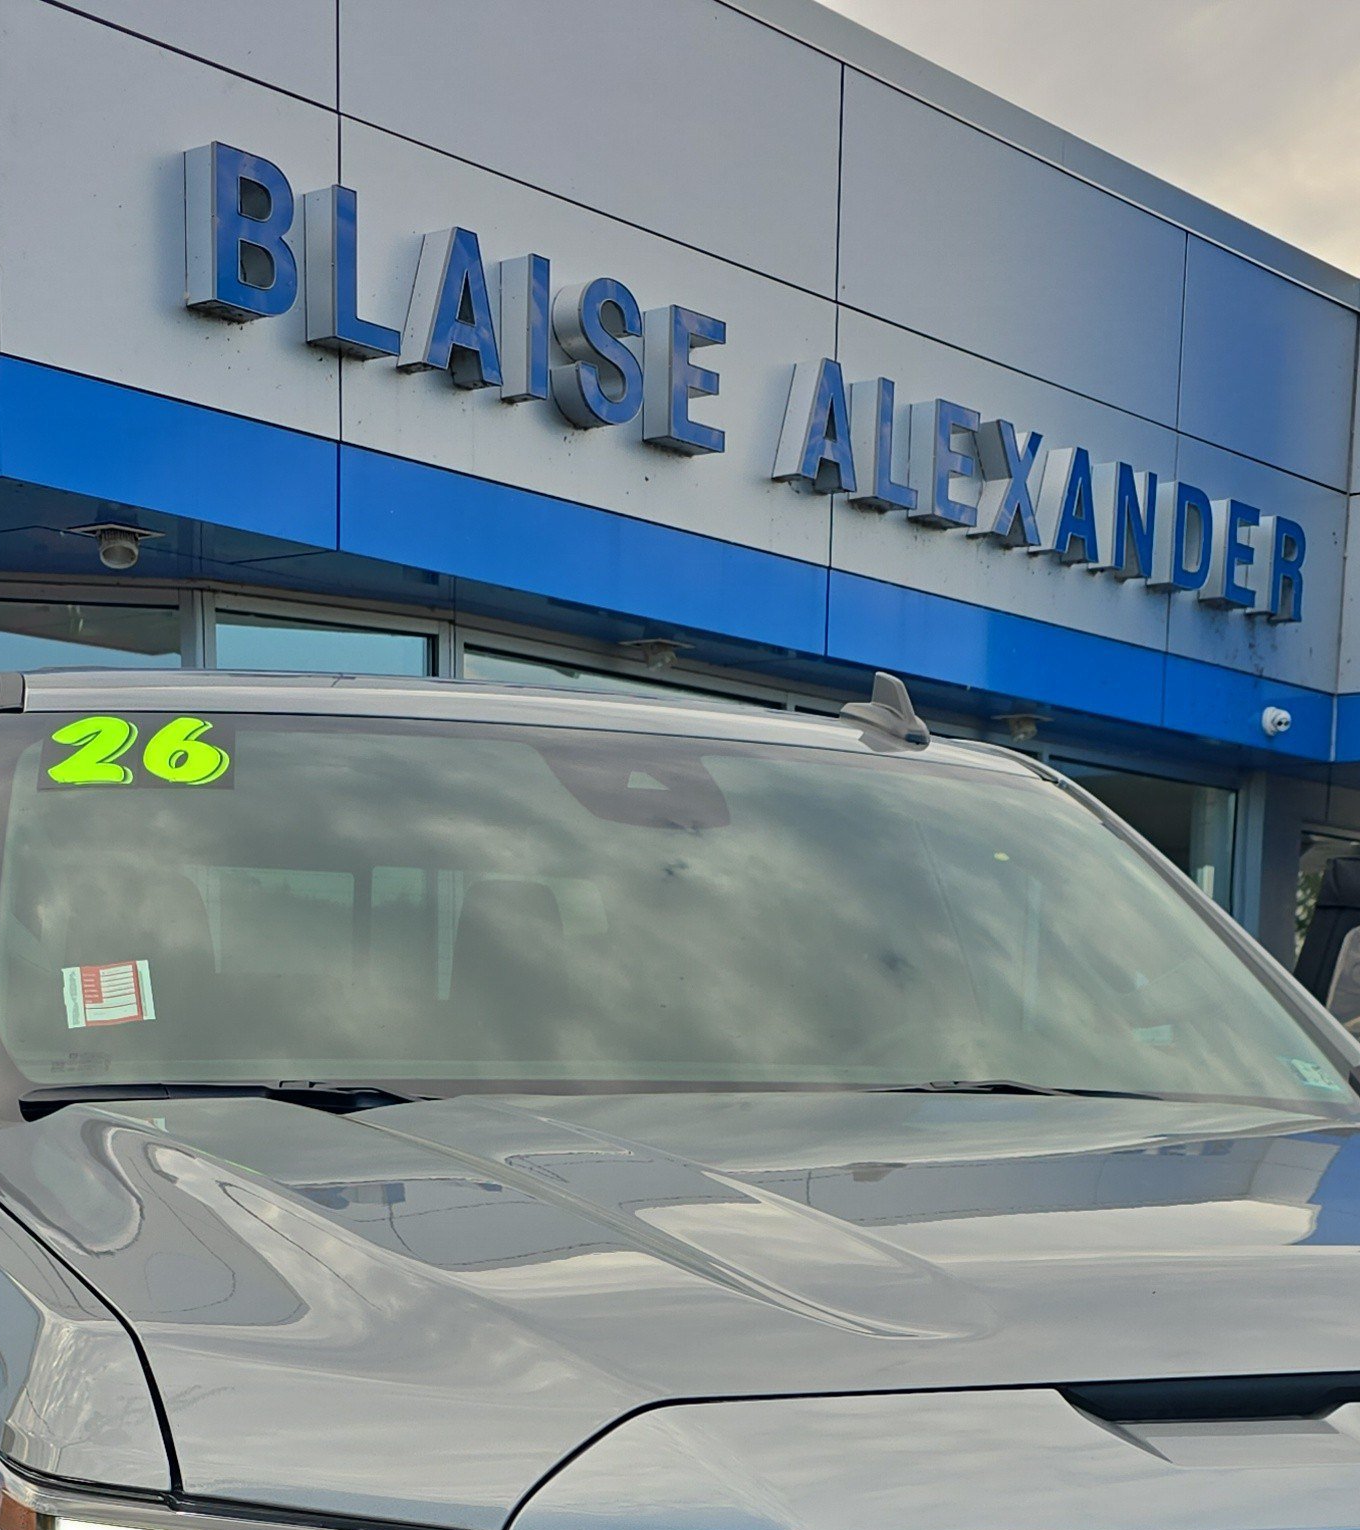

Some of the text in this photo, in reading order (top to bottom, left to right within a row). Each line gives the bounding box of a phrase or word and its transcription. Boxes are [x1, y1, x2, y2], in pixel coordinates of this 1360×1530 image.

[184, 140, 1308, 624] BLAISE ALEXANDER
[47, 716, 232, 786] 26
